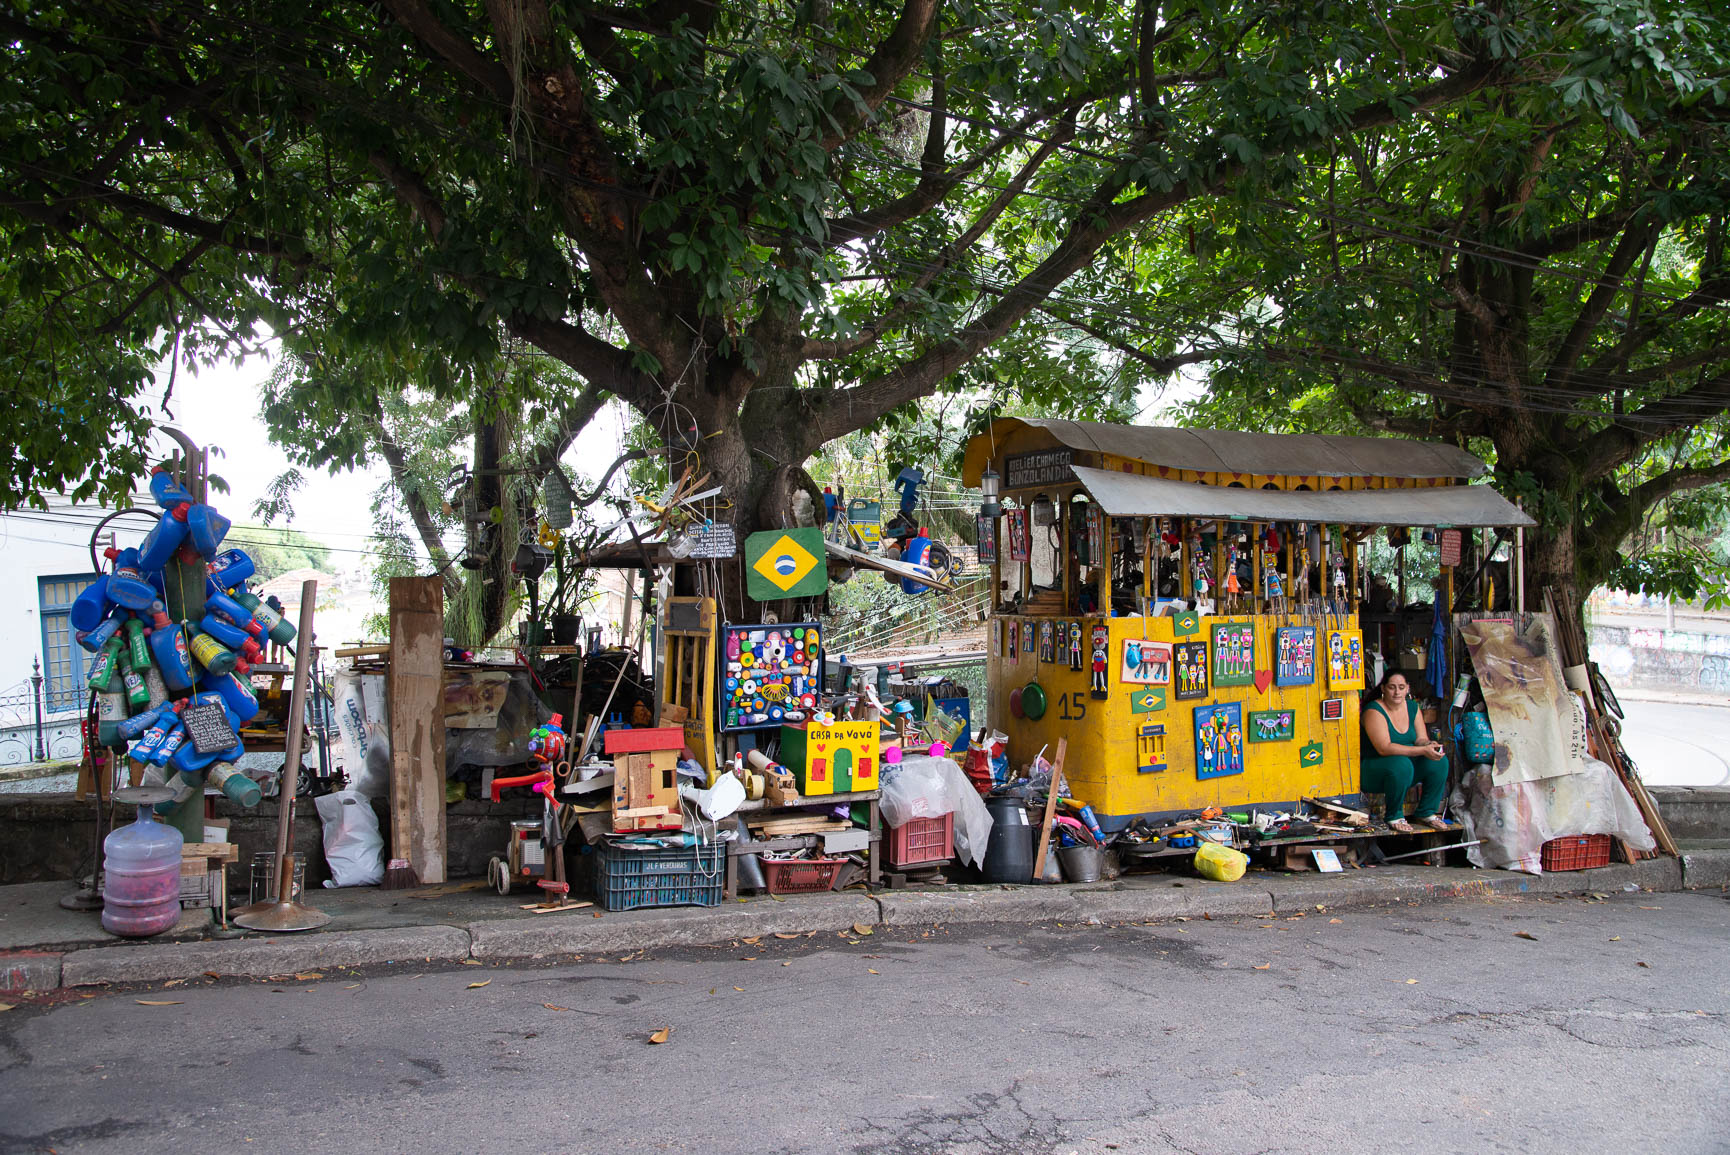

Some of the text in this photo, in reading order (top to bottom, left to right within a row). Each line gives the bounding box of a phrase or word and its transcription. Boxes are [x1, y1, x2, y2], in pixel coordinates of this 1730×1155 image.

[1058, 692, 1086, 720] 15
[346, 698, 368, 759] Ortobom
[811, 730, 831, 740] CASA
[834, 732, 844, 740] DA
